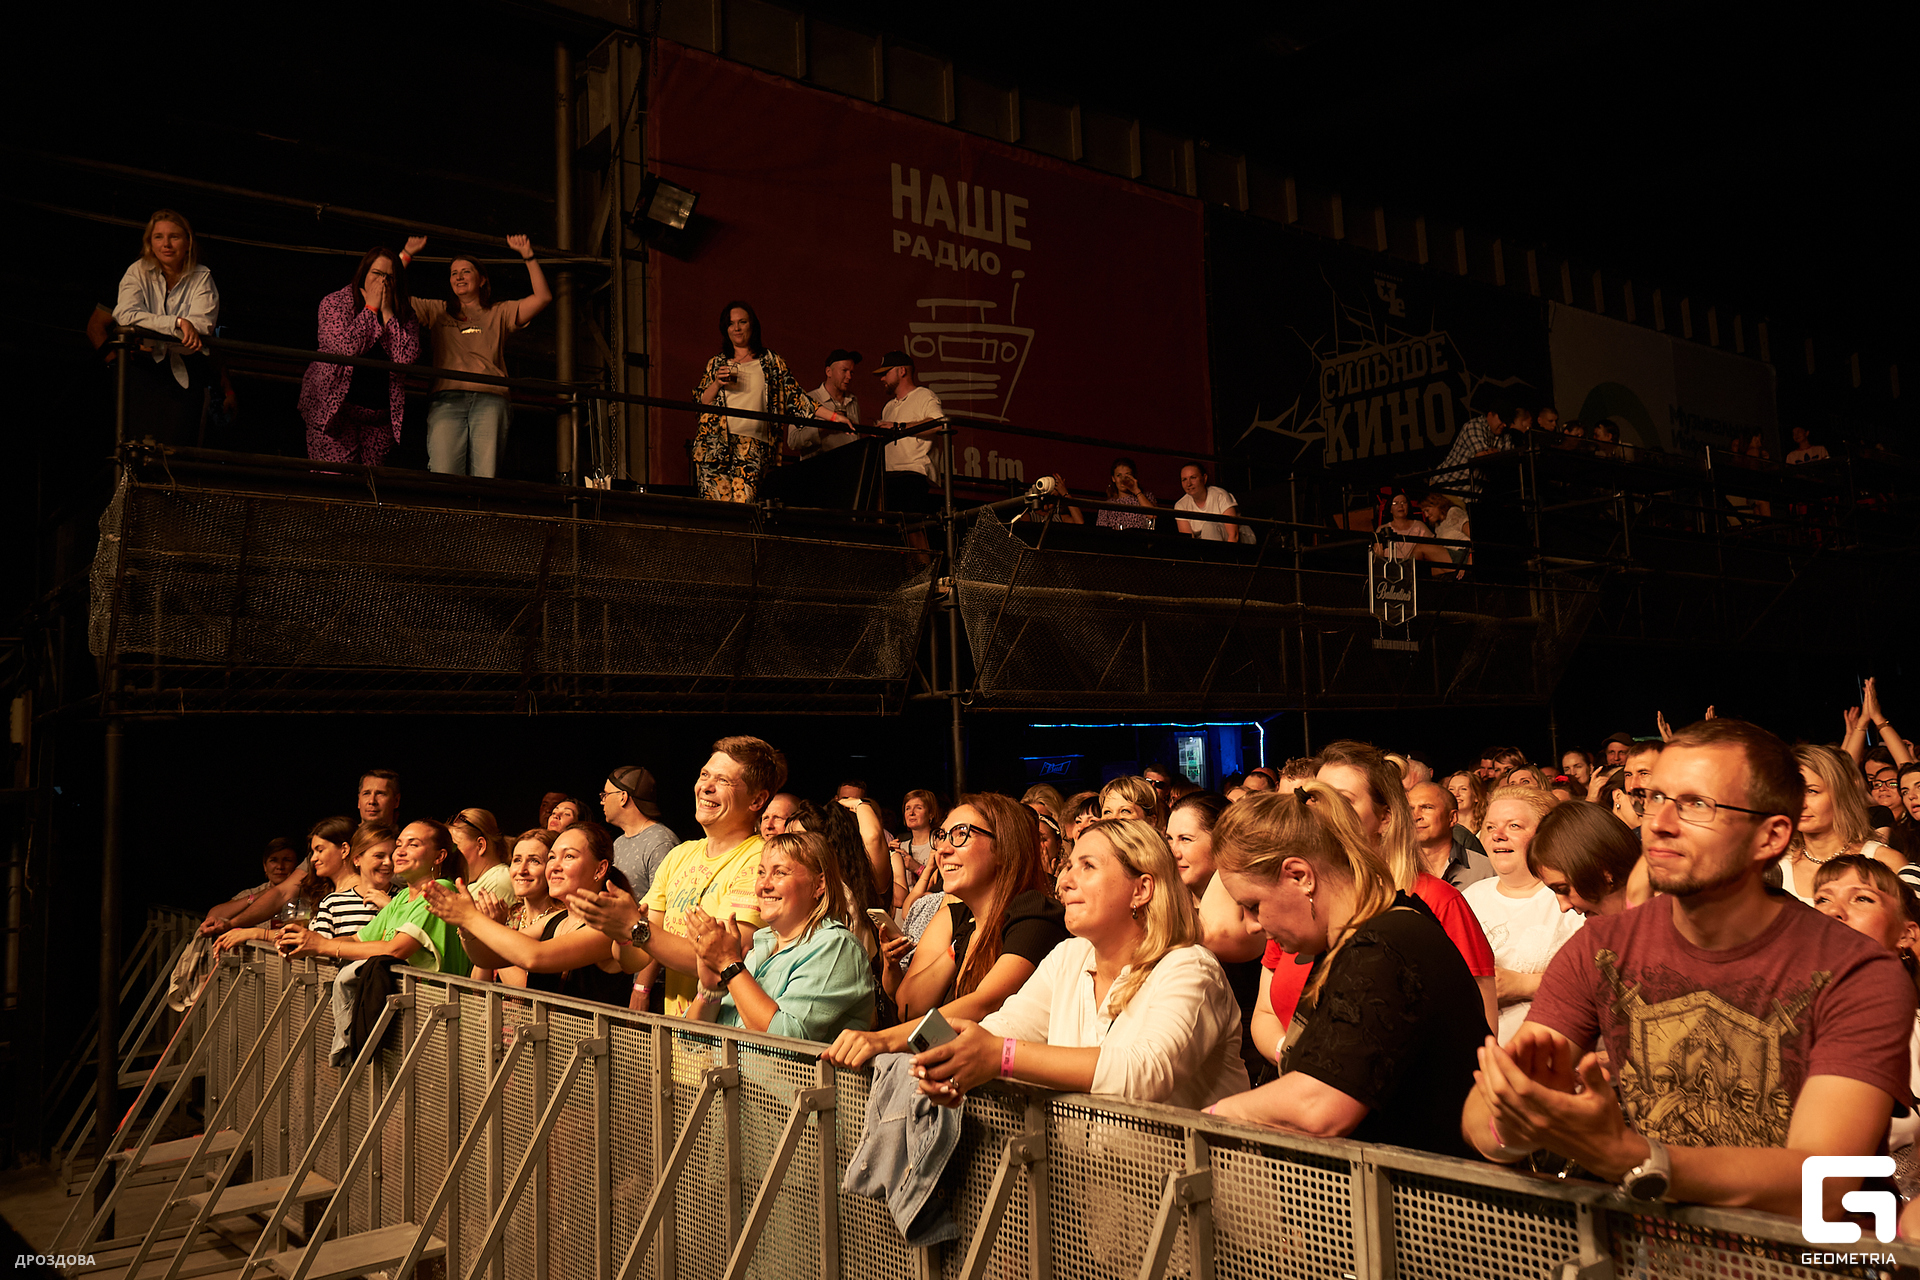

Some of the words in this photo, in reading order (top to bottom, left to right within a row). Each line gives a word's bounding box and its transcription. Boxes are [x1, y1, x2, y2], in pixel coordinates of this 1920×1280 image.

[890, 162, 1031, 251] НАШЕ
[892, 228, 1001, 276] РАДИО
[1322, 334, 1450, 401] СИЛЬНОЕ
[1324, 380, 1457, 464] КИНО
[987, 449, 1025, 483] fm
